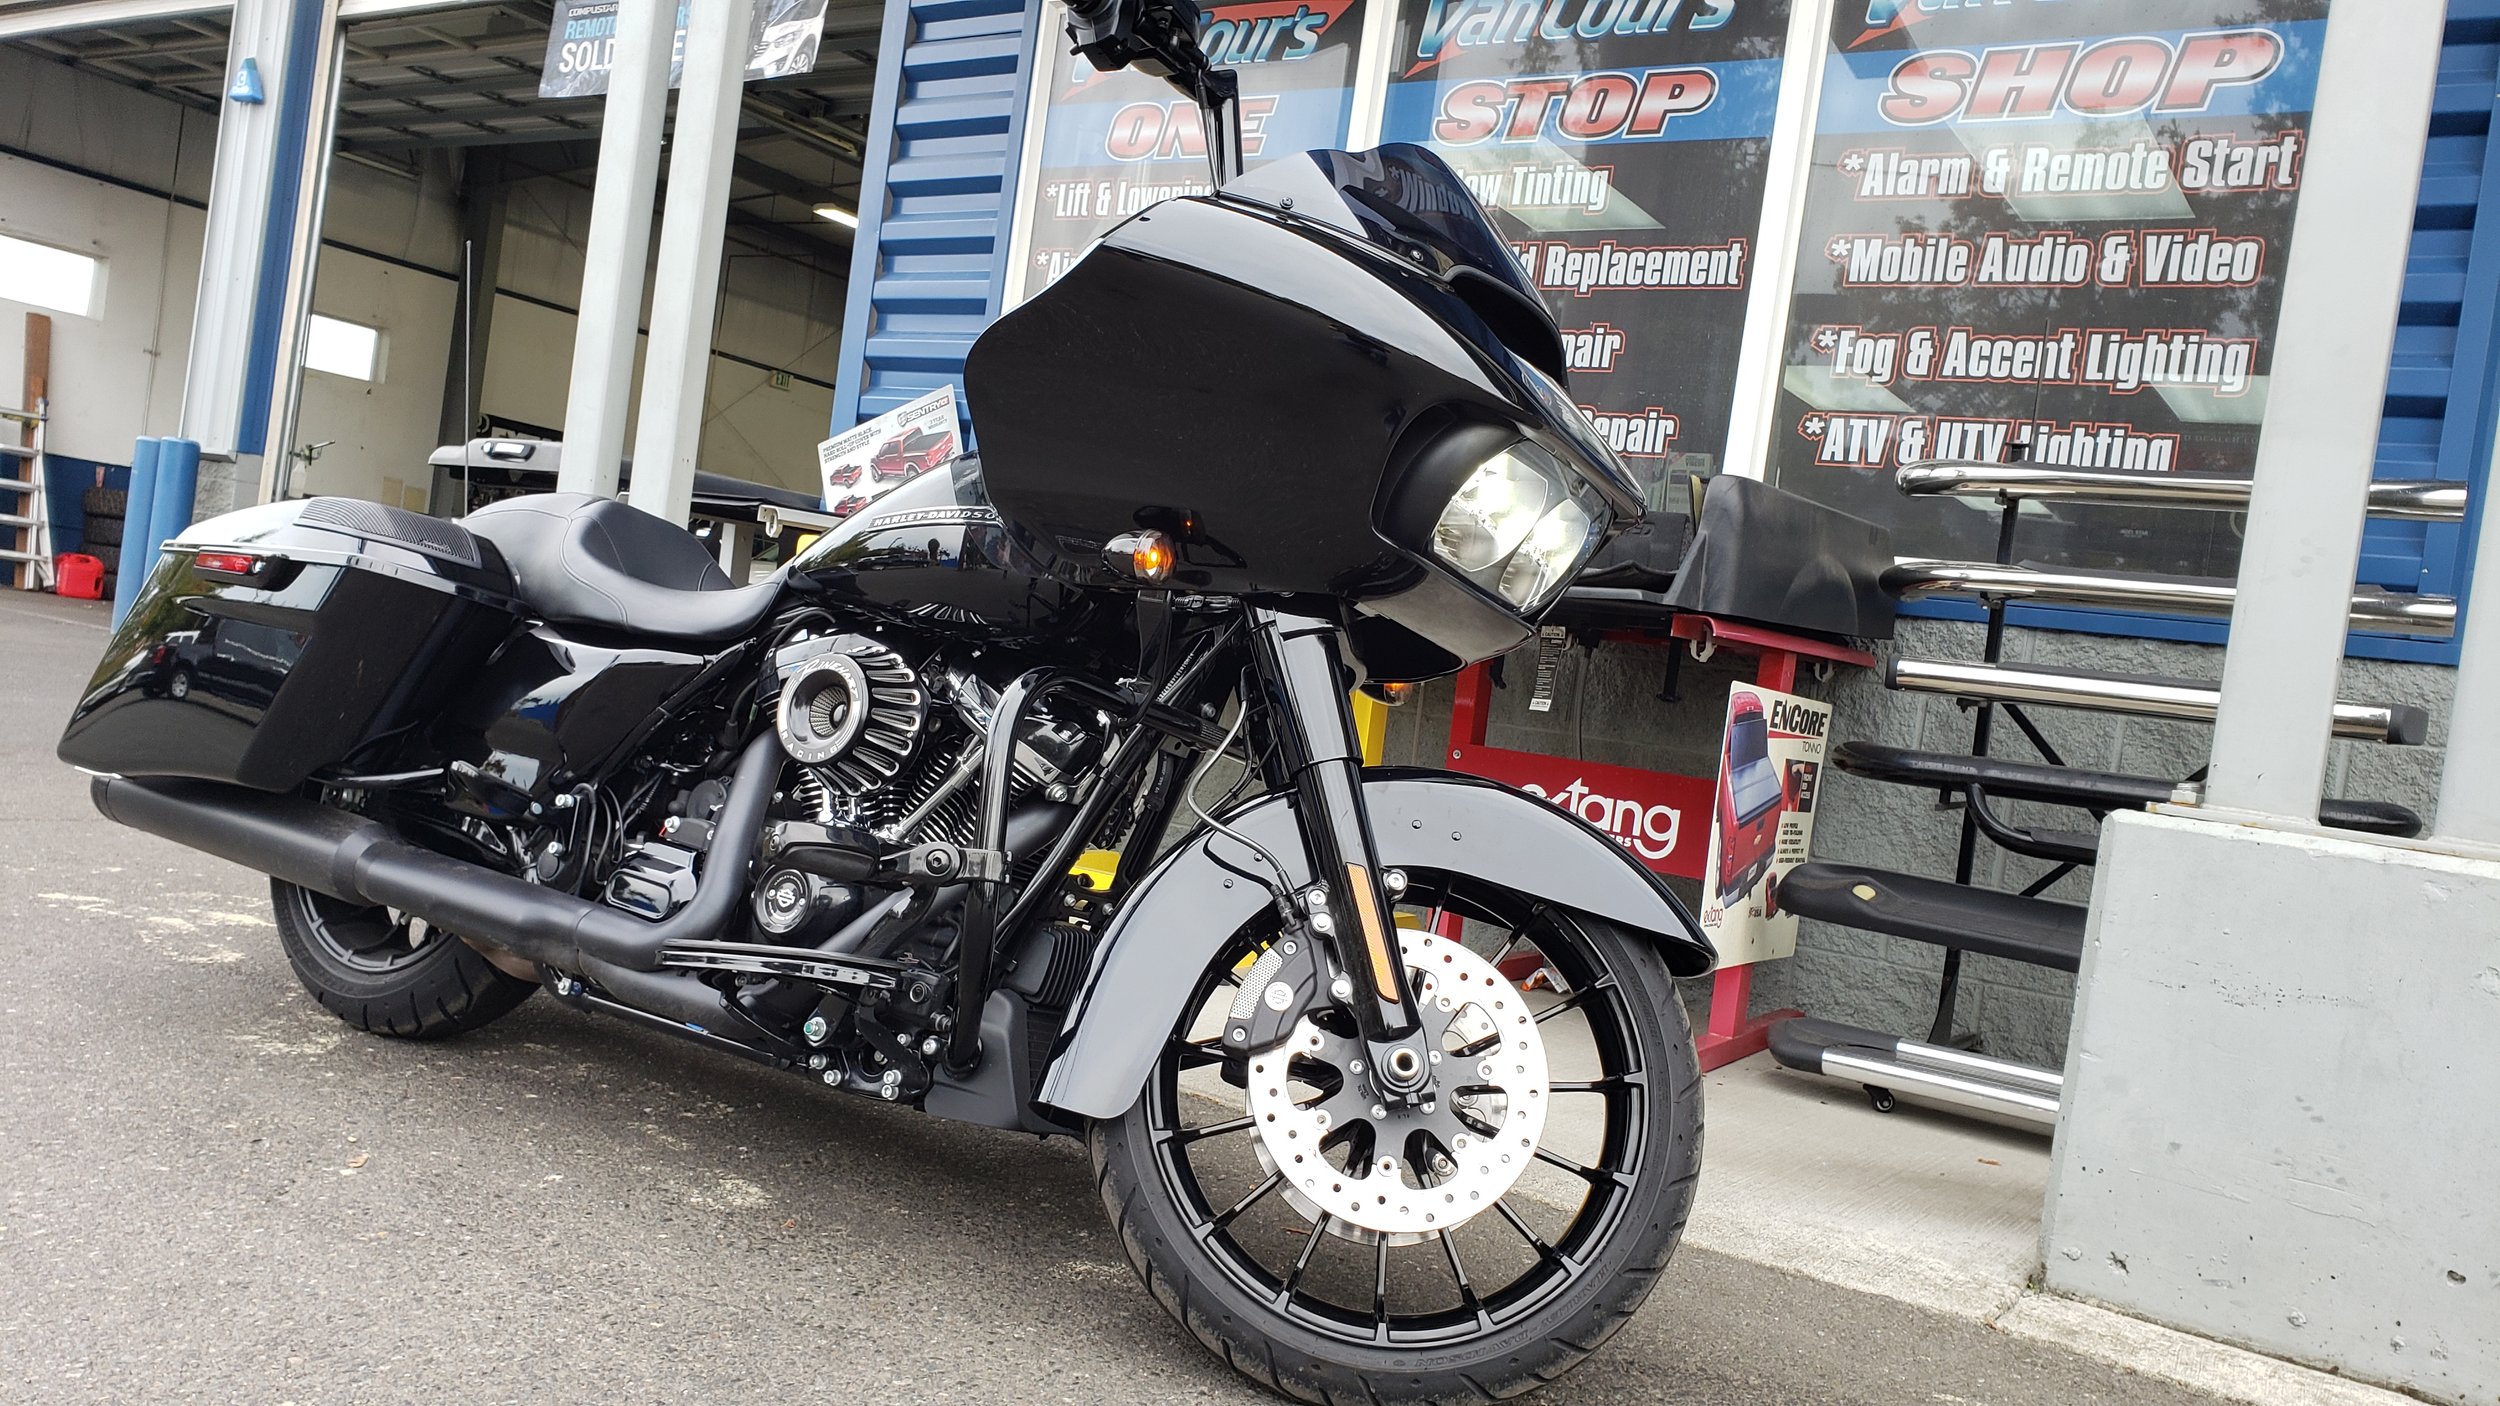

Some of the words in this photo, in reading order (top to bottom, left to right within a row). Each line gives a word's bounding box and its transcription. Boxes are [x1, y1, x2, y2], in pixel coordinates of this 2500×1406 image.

[564, 16, 617, 40] REMOT
[1417, 0, 1737, 59] VanCours
[1878, 28, 2285, 127] SHOP
[1105, 95, 1280, 161] ONE
[1432, 66, 1719, 146] STOP
[1982, 148, 2011, 193] &
[2020, 144, 2168, 192] Remote
[2181, 136, 2297, 188] Start
[1095, 181, 1113, 217] &
[1116, 179, 1213, 216] Lowei
[1512, 165, 1610, 211] Tinting
[1543, 242, 1744, 294] Replacement
[1978, 236, 2088, 283] Audio
[2099, 235, 2131, 282] &
[2145, 234, 2258, 283] Video
[1562, 327, 1622, 368] pair
[1905, 331, 1934, 377] &
[1943, 331, 2076, 380] Accent
[2085, 332, 2251, 394] Lighting
[905, 400, 942, 421] SENTRY
[1898, 420, 1926, 464] &
[1935, 422, 2008, 463] UTV
[873, 510, 996, 527] HARLEY-DAVIDSO
[797, 658, 859, 700] RINEHART
[1769, 698, 1829, 738] ENCORE
[780, 729, 840, 761] RACING
[1802, 740, 1822, 755] TONNO
